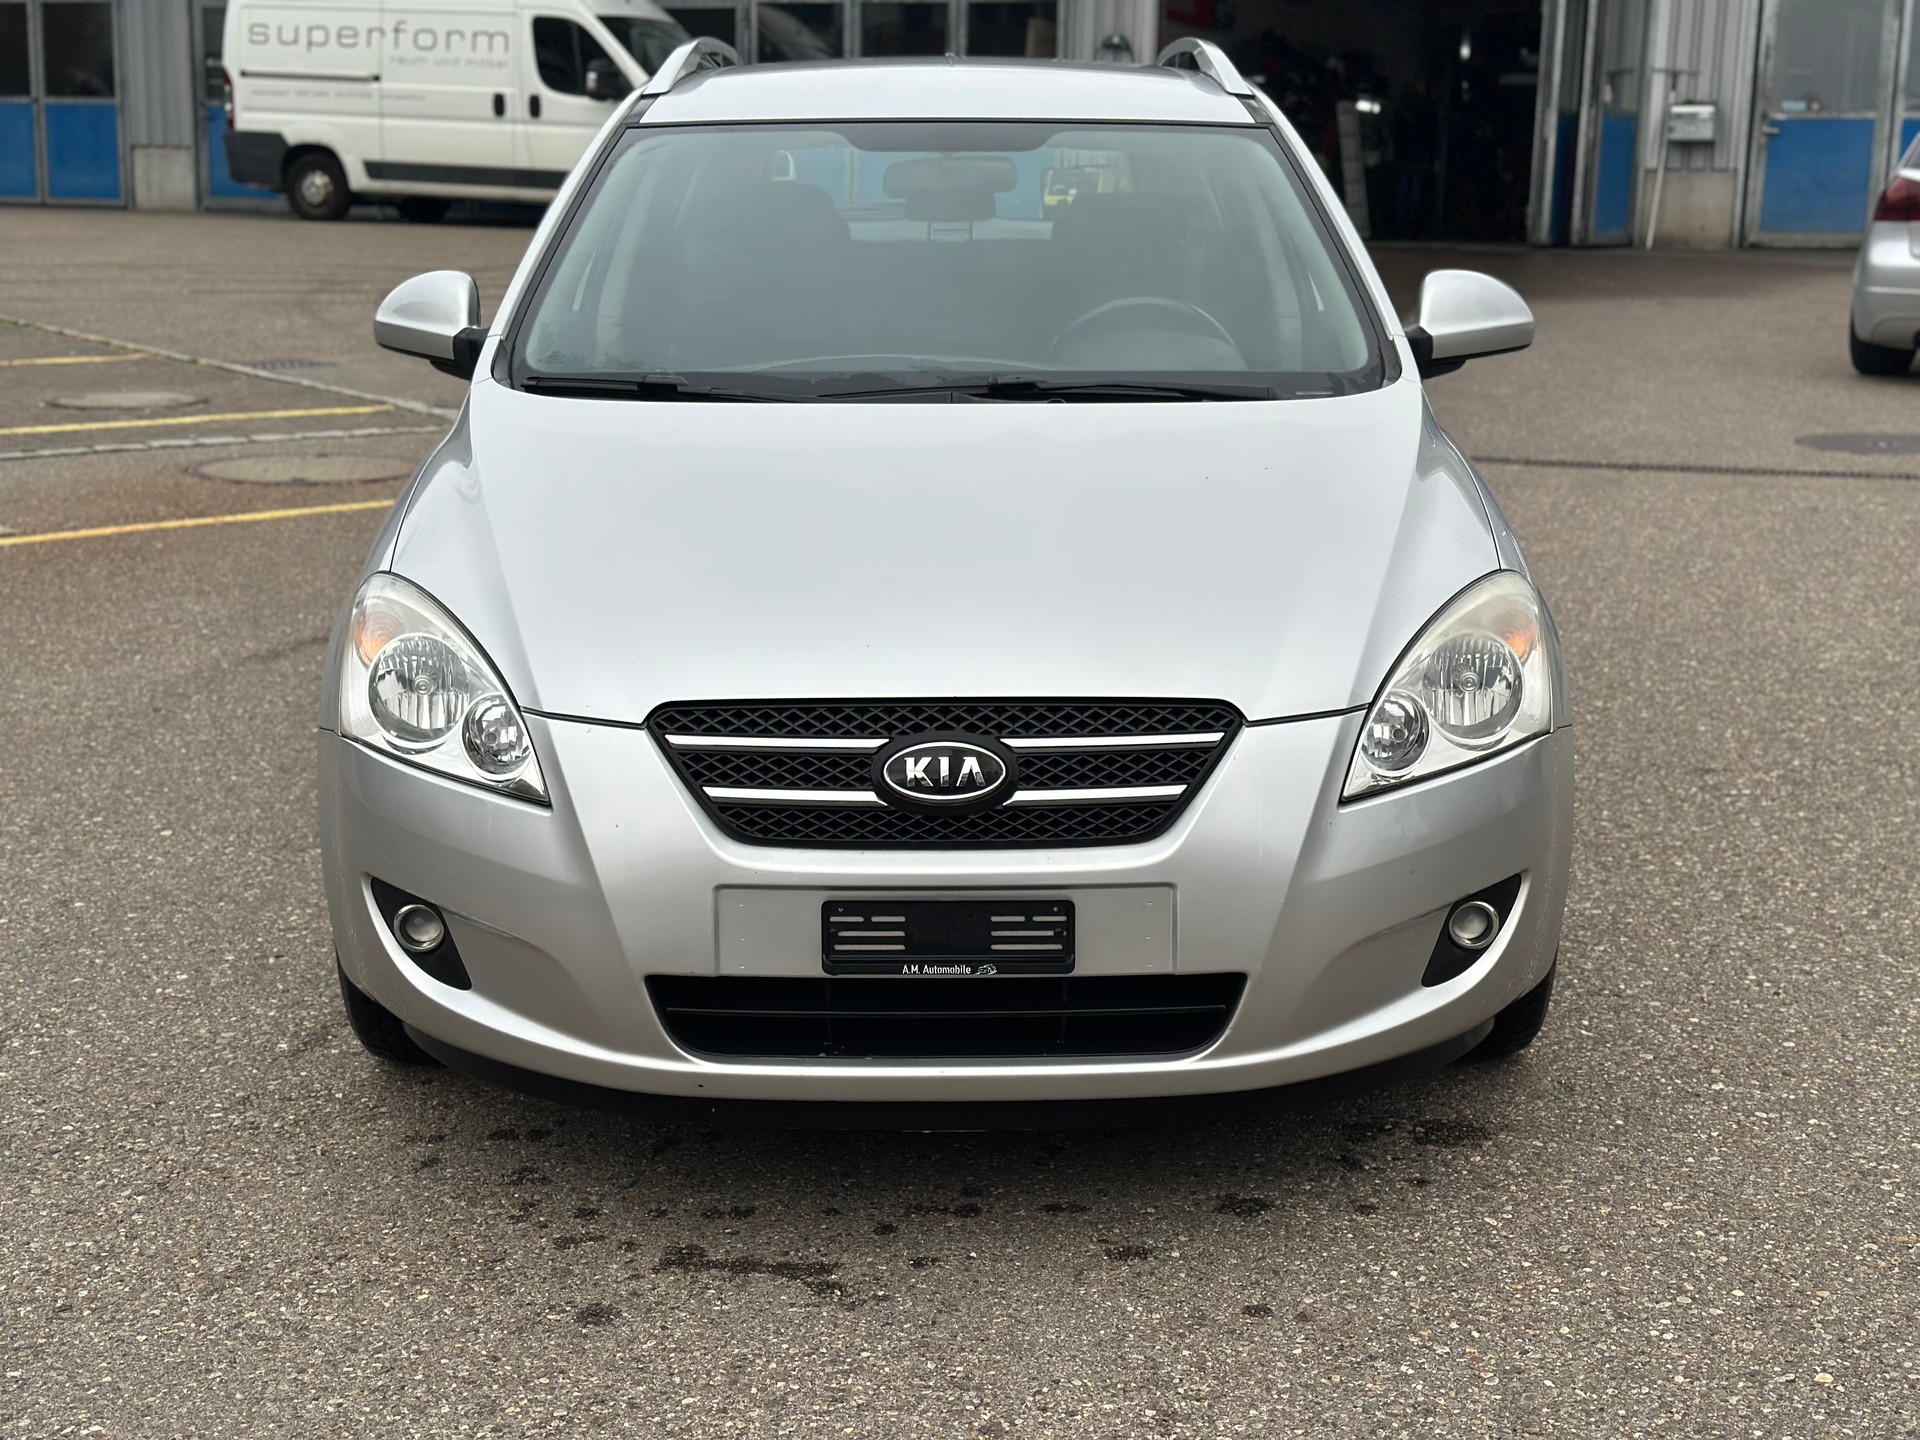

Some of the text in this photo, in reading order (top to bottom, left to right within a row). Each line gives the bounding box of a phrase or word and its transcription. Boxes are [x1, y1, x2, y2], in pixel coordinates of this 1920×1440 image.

[248, 20, 511, 53] superform
[904, 756, 986, 787] KIA
[902, 964, 971, 974] A.M. Automobile
